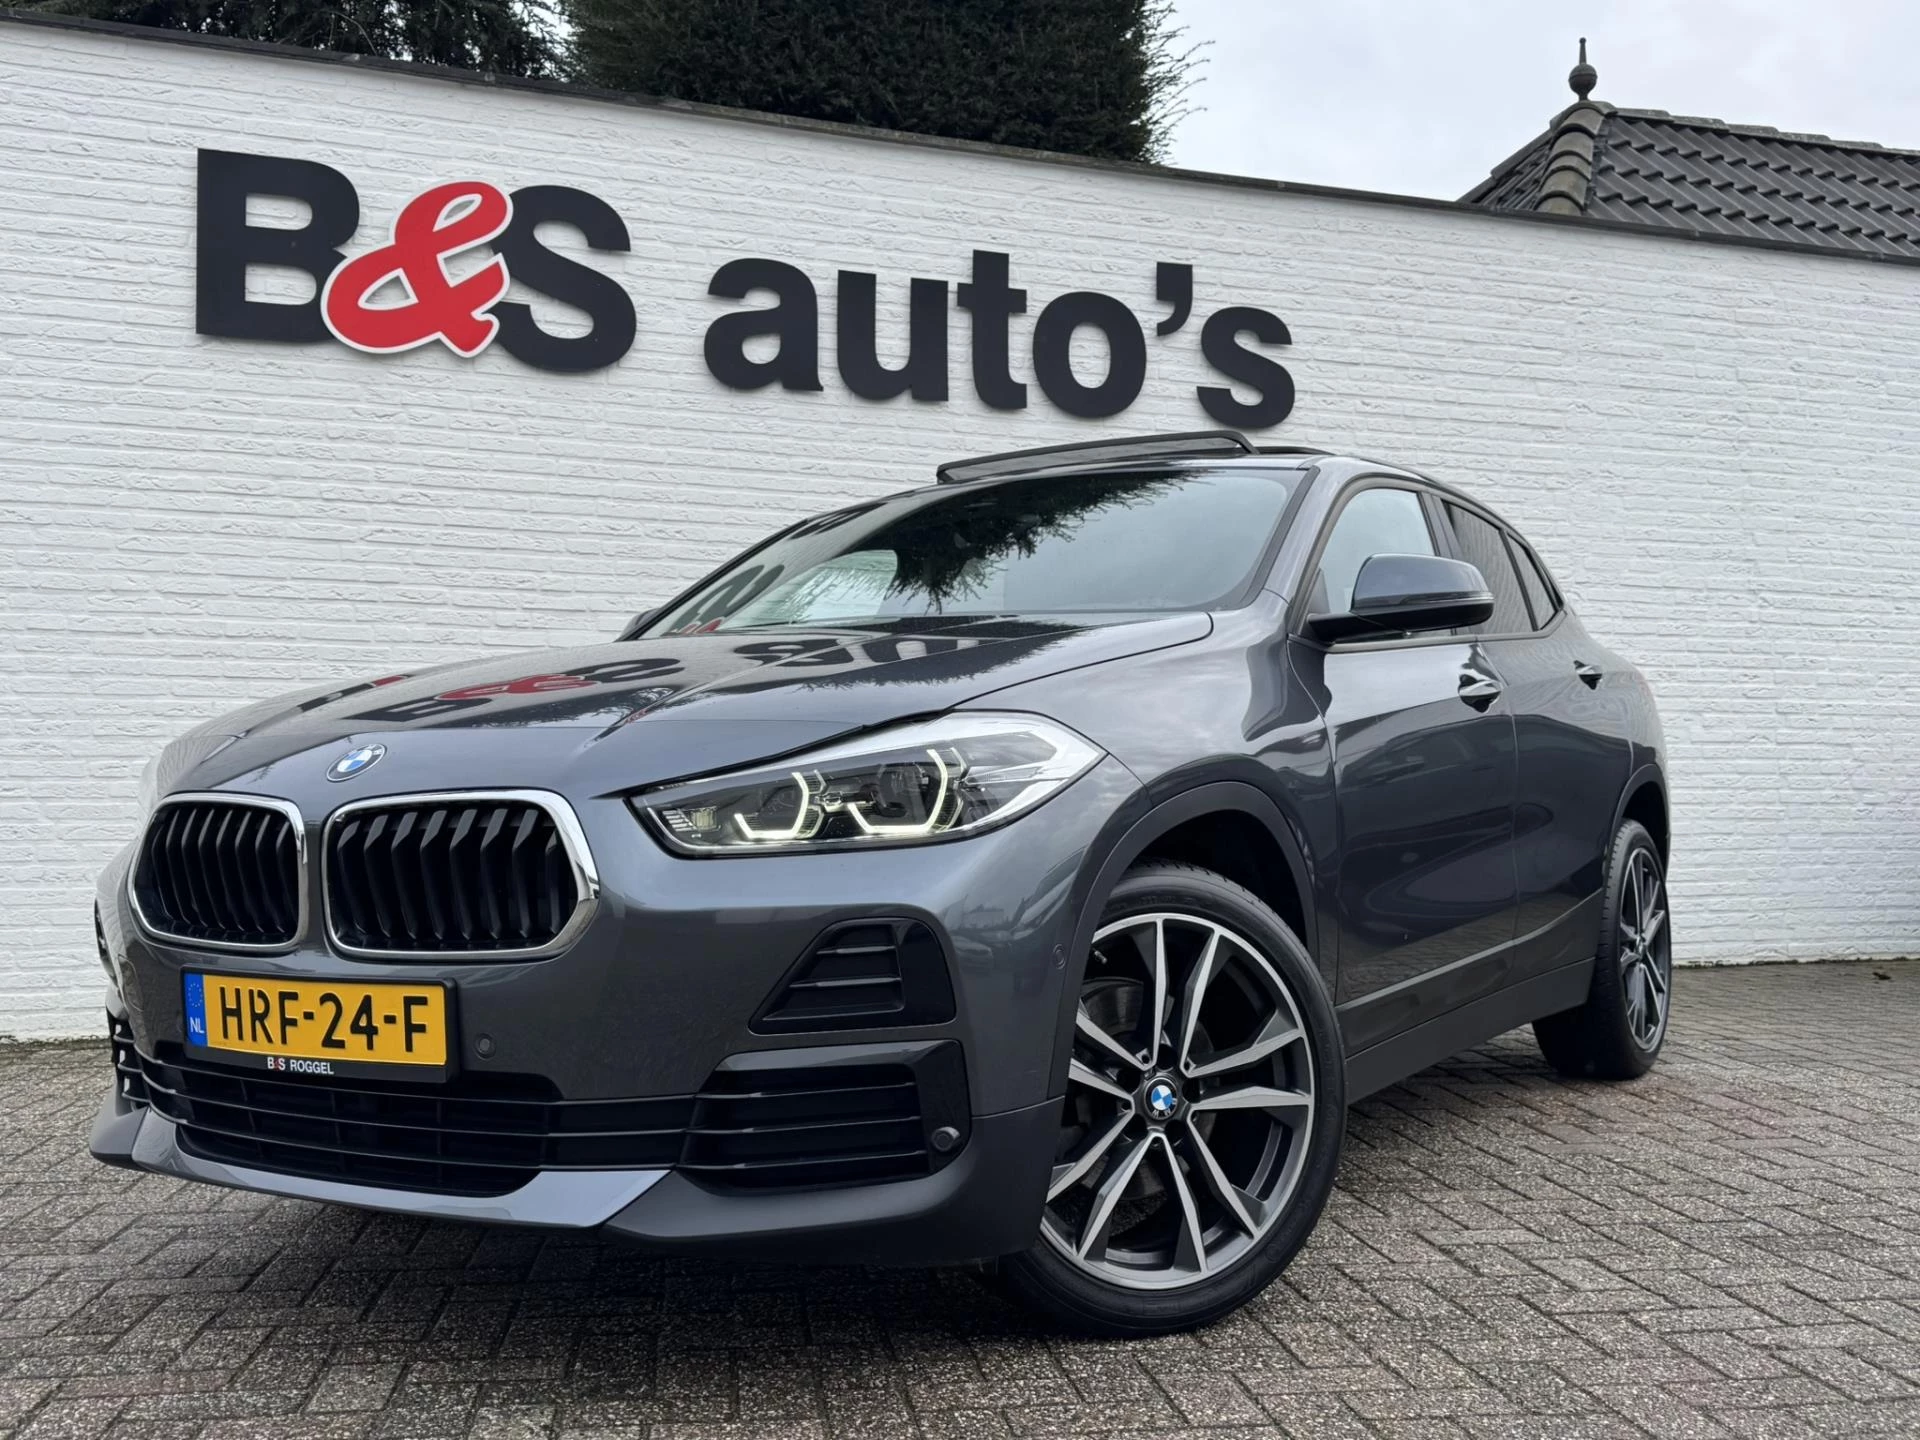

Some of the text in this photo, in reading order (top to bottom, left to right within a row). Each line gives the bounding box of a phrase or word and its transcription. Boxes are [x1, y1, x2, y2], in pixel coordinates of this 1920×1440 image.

[196, 148, 1296, 430] B&S auto's
[190, 1016, 205, 1034] NL
[219, 986, 429, 1053] HRF-24-F
[290, 1059, 335, 1075] ROGGEL
